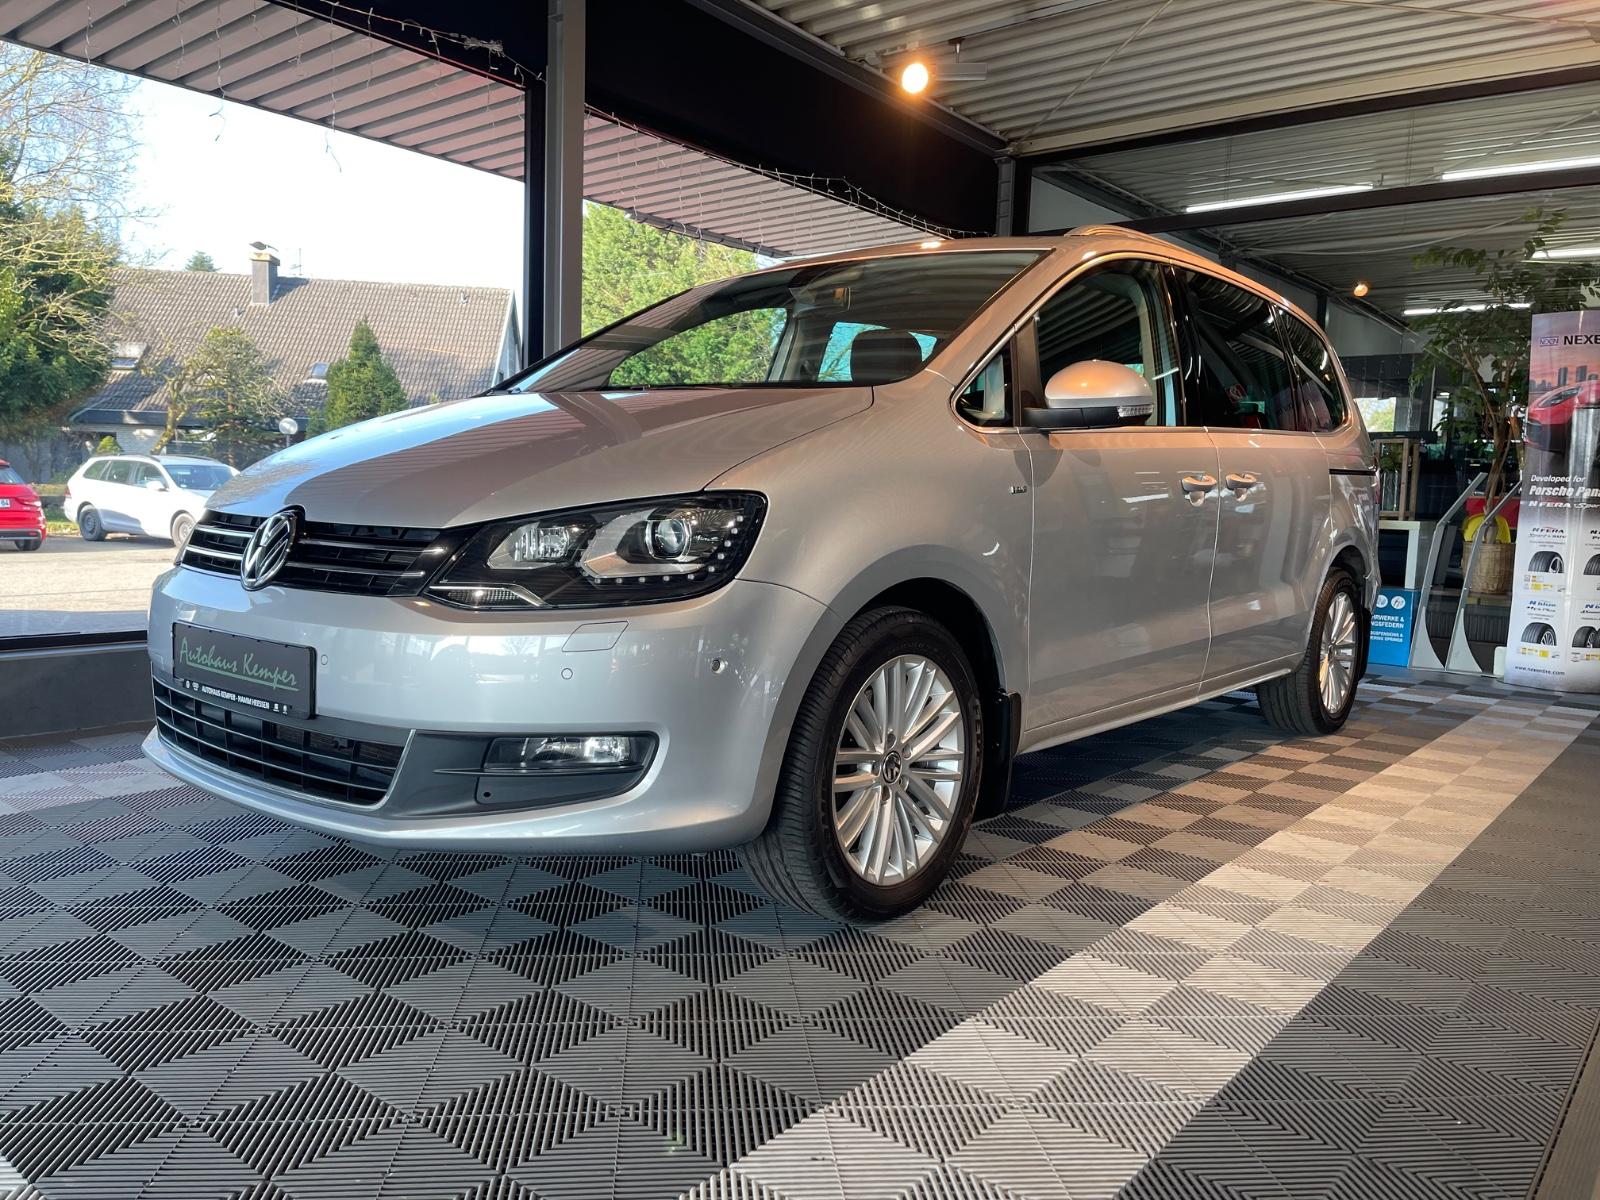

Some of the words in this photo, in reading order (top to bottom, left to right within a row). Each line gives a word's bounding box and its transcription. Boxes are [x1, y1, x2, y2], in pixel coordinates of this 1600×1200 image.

[1530, 474, 1571, 484] Developed
[1572, 475, 1586, 483] for
[1529, 485, 1574, 497] Porsche
[179, 637, 238, 673] Autohaus
[243, 653, 297, 690] Kemper
